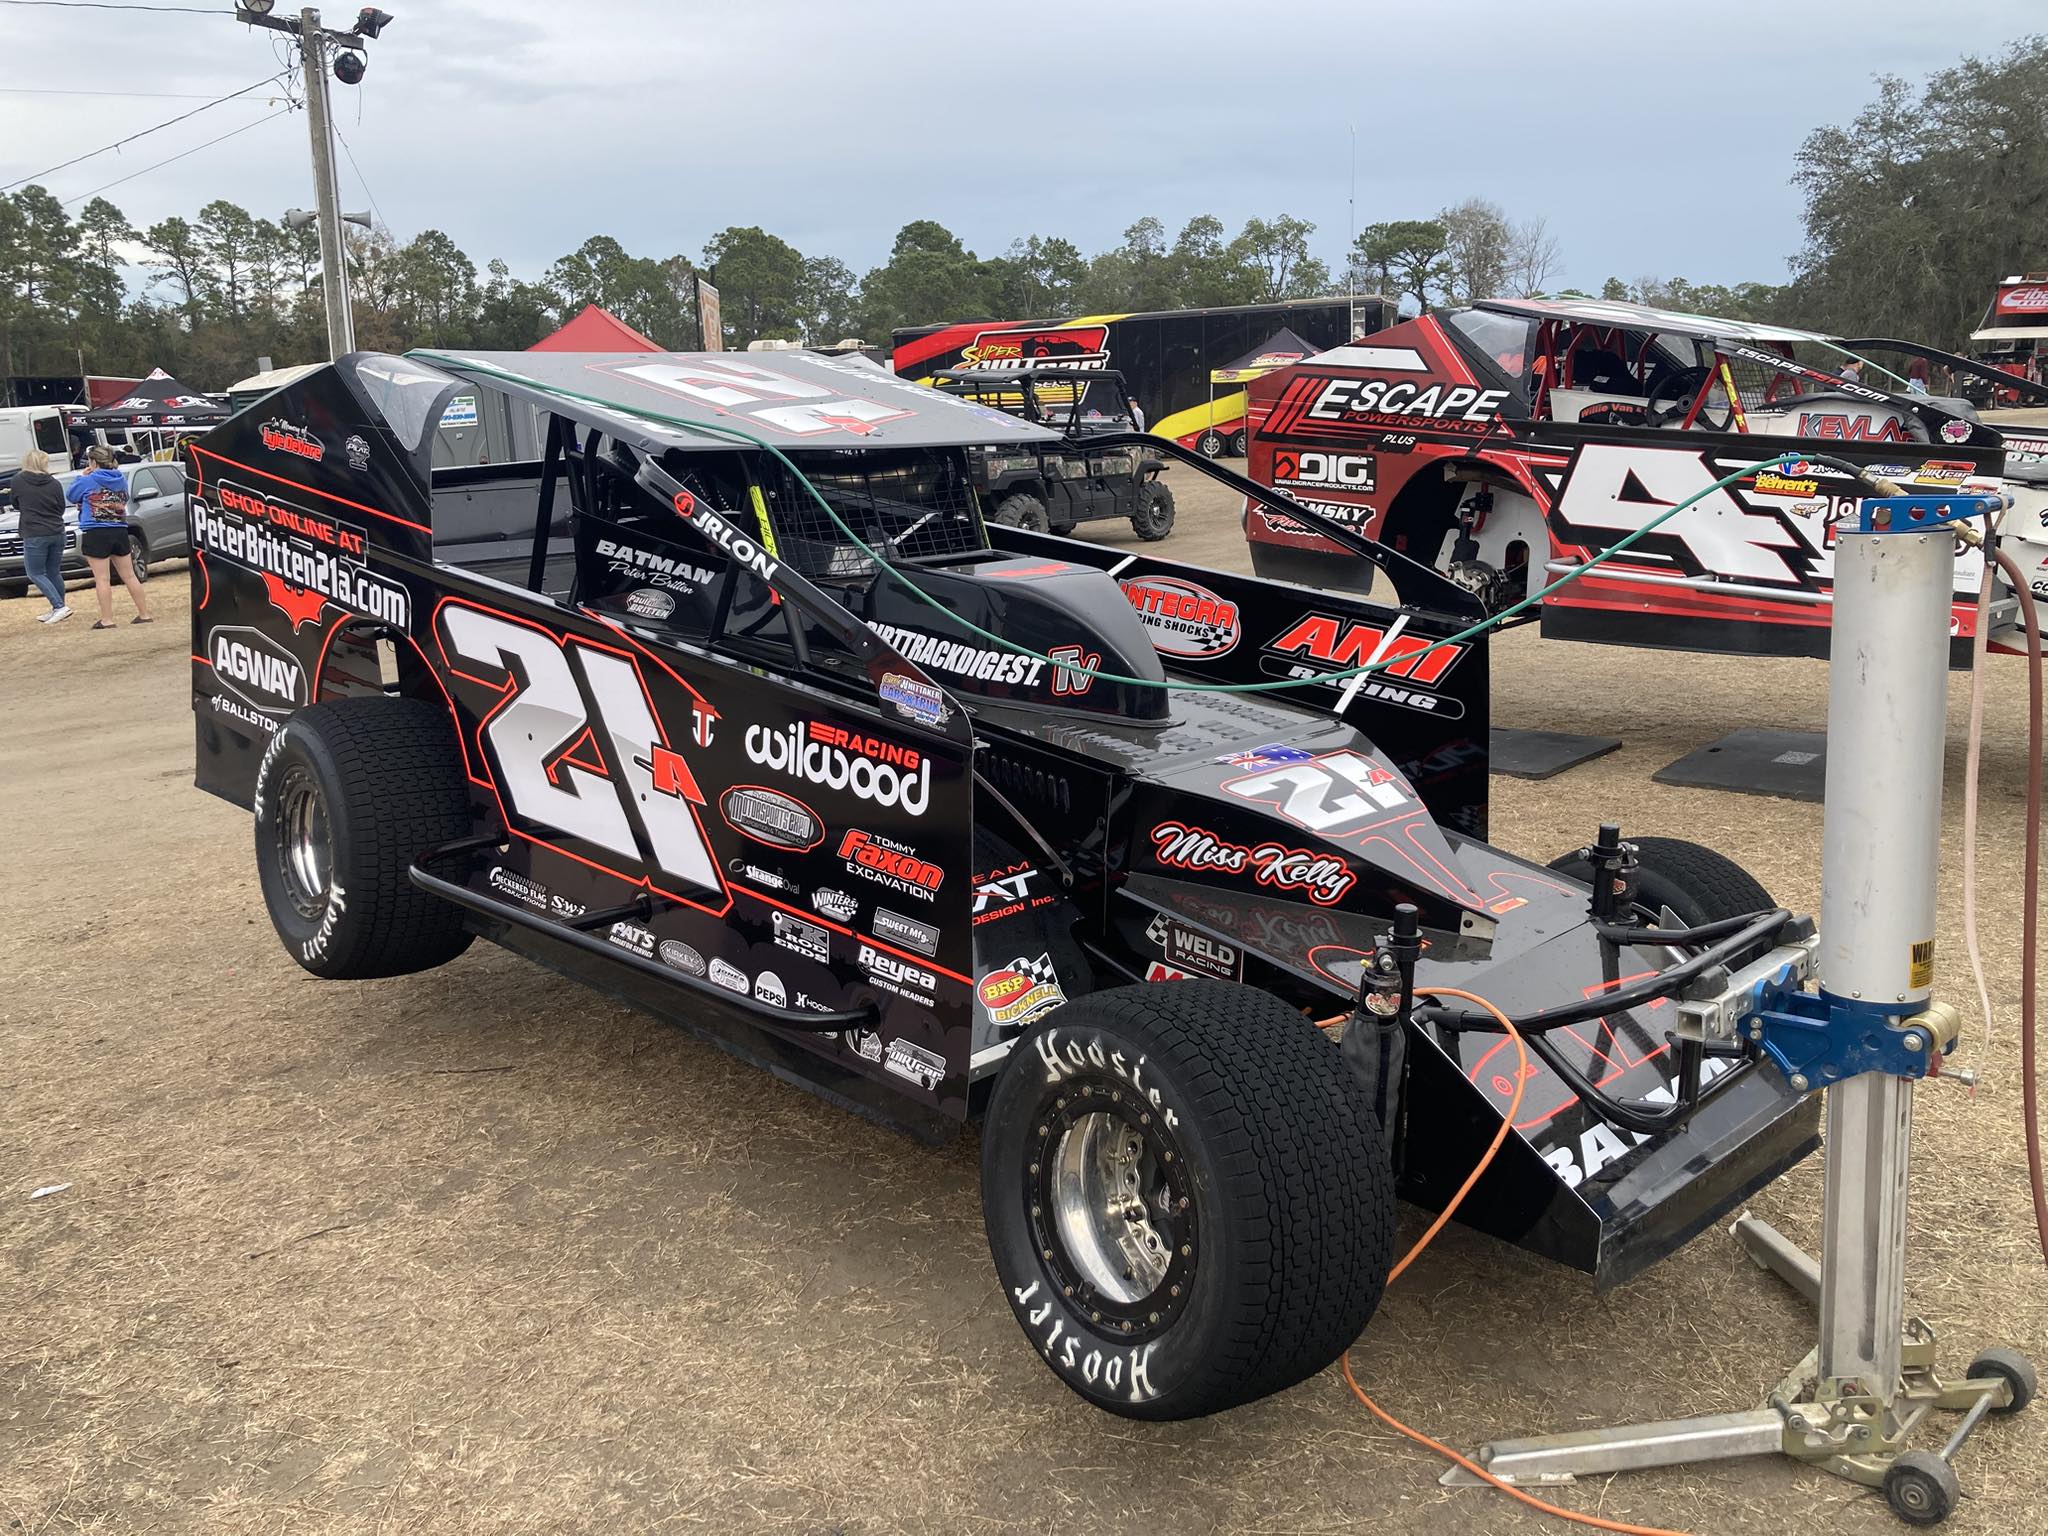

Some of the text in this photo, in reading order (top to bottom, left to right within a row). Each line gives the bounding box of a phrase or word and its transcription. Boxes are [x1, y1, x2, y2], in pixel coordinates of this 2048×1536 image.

[953, 344, 1022, 369] SUPER
[1308, 379, 1511, 422] ESCAPE
[1611, 403, 1633, 413] Van
[1342, 411, 1489, 433] POWERSPORTS
[263, 427, 323, 461] Lyle DeVore
[1381, 433, 1417, 446] PLUS
[1755, 475, 1819, 493] Behrent's
[220, 488, 364, 555] SHOP ONLINE AT
[691, 510, 779, 581] JRLON
[193, 504, 406, 628] PeterBritten21a.com
[595, 539, 716, 585] BATMAN
[607, 560, 695, 595] Peter Britten
[629, 603, 670, 618] BRITTEN
[1163, 618, 1211, 638] SHOCKS
[216, 635, 299, 702] AGWAY
[210, 693, 222, 712] of
[899, 679, 942, 699] WHITTAKER
[833, 731, 920, 770] RACING
[744, 720, 931, 816] wilwood
[731, 791, 790, 831] MOTORSPORTS
[874, 834, 916, 856] TOMMY
[840, 830, 943, 890] Faxon
[972, 860, 1030, 884] EAM
[1156, 826, 1352, 901] Miss Kelly
[490, 866, 547, 904] CHECKERED FLAG
[782, 878, 800, 895] Oval
[845, 861, 935, 902] EXCAVATION
[1031, 895, 1055, 908] Inc.
[611, 921, 655, 949] PAT'S
[874, 917, 909, 935] SWEET
[666, 947, 696, 964] KIRKEY
[773, 936, 827, 963] ENDS
[785, 932, 827, 954] ROD
[1174, 928, 1236, 966] WELD
[858, 944, 936, 991] Reyea
[1175, 949, 1232, 976] RACING
[757, 987, 786, 1007] PEPSI
[868, 976, 935, 1007] CUSTOM HEADERS
[983, 975, 1026, 1001] BRP
[995, 985, 1058, 1022] BICKNELL
[1013, 1280, 1157, 1401] Hoosier
